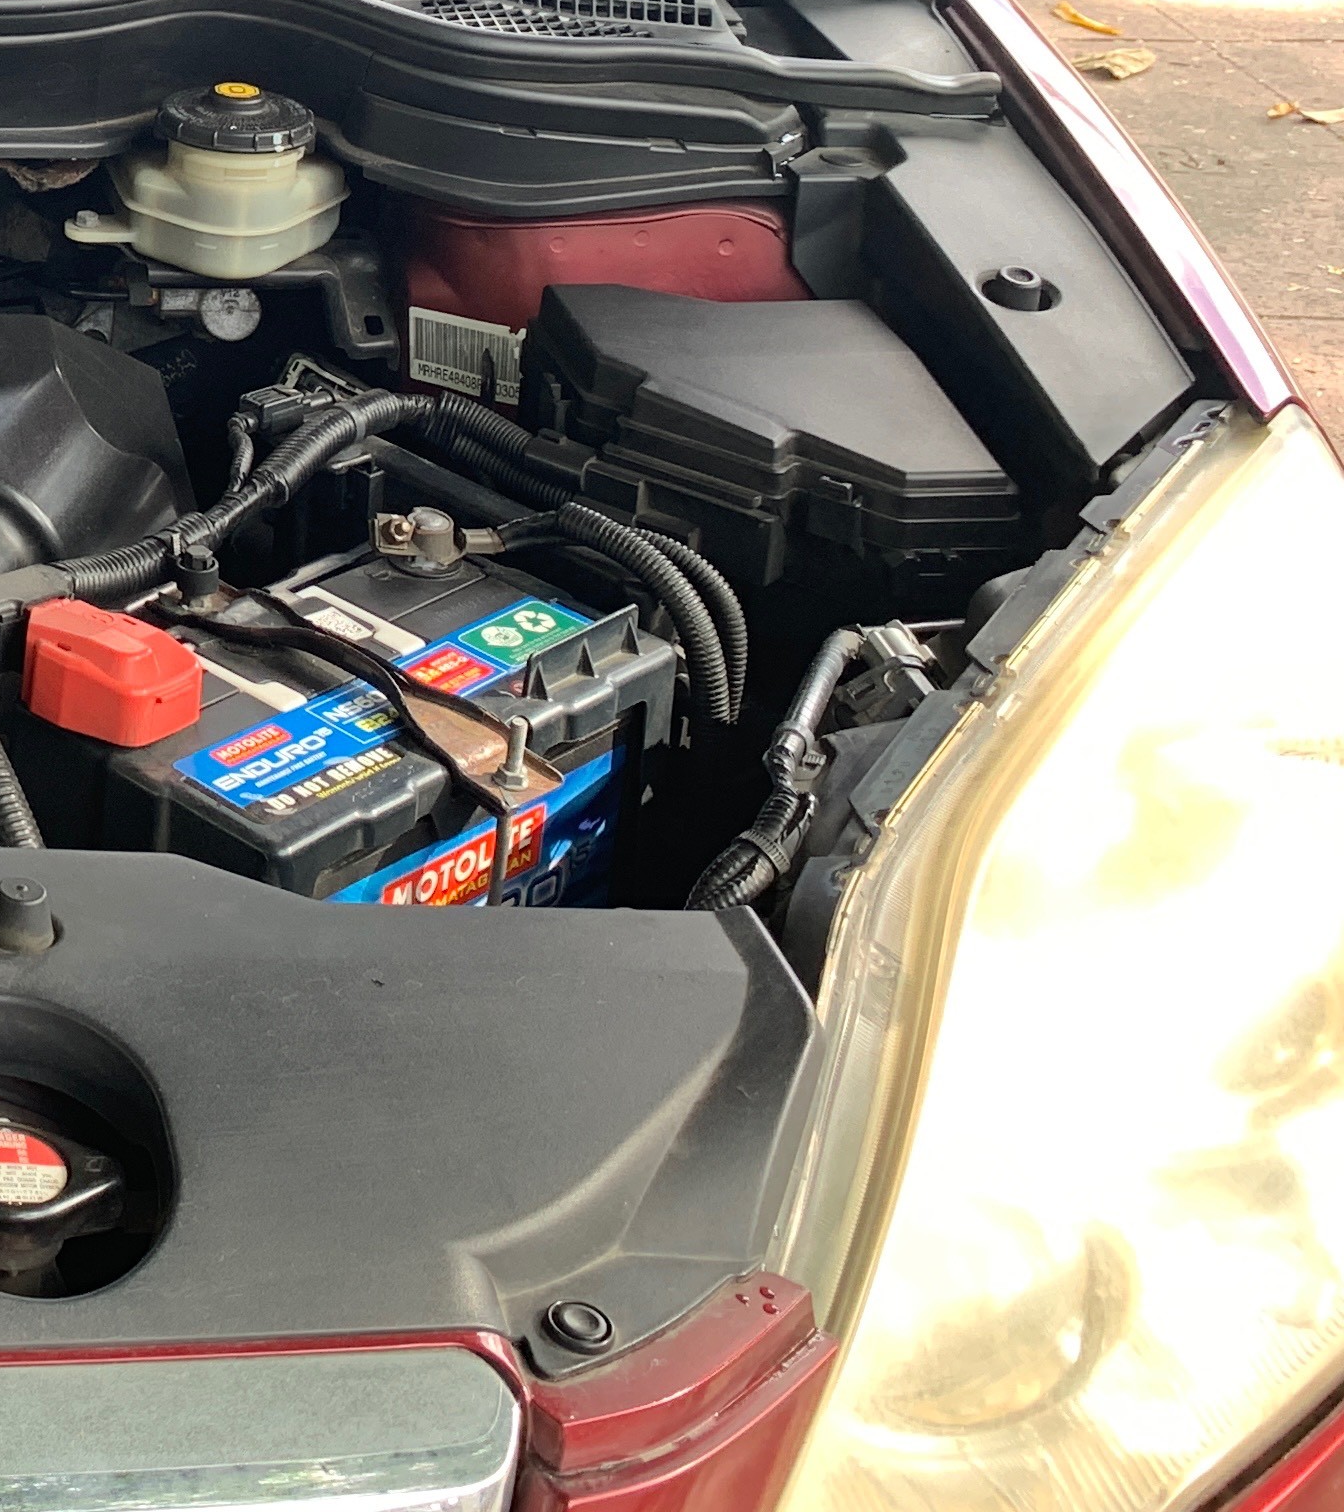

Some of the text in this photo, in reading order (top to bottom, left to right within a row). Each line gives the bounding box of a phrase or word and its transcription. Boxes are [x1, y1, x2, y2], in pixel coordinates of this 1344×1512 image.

[215, 725, 282, 762] MOTOLITE
[267, 792, 297, 811] DO
[292, 777, 330, 798] NOT
[326, 746, 395, 782] REMOVE
[392, 818, 536, 906] MOTOLTE
